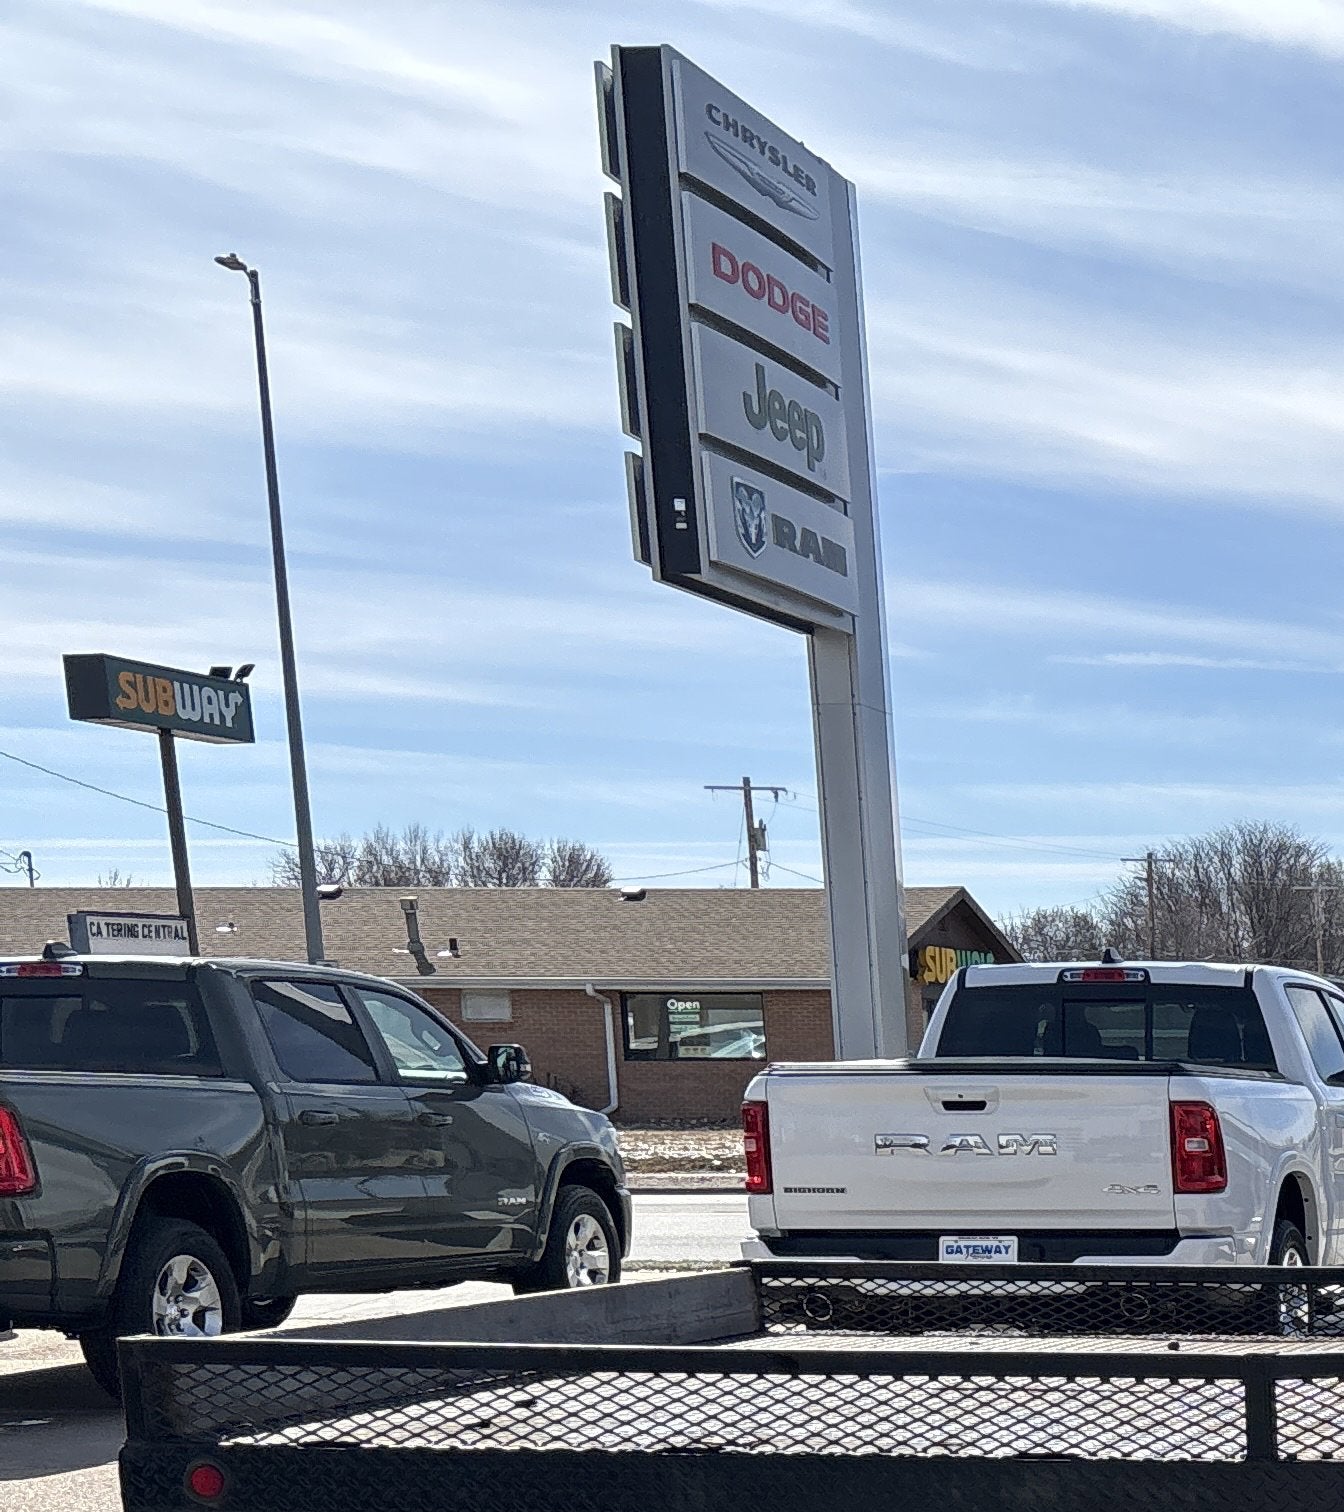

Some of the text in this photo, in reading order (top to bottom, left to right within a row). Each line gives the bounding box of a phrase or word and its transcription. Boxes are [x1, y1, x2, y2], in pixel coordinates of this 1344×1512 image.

[705, 102, 818, 197] CHRYSLER
[711, 241, 831, 345] DODGE
[742, 362, 825, 473] Jeep
[771, 512, 848, 577] RAM
[116, 671, 244, 728] SUBWAY
[141, 923, 187, 941] CENTRAL
[667, 998, 701, 1012] Open
[874, 1133, 1057, 1156] RAM
[945, 1244, 1012, 1256] GATEWAY
